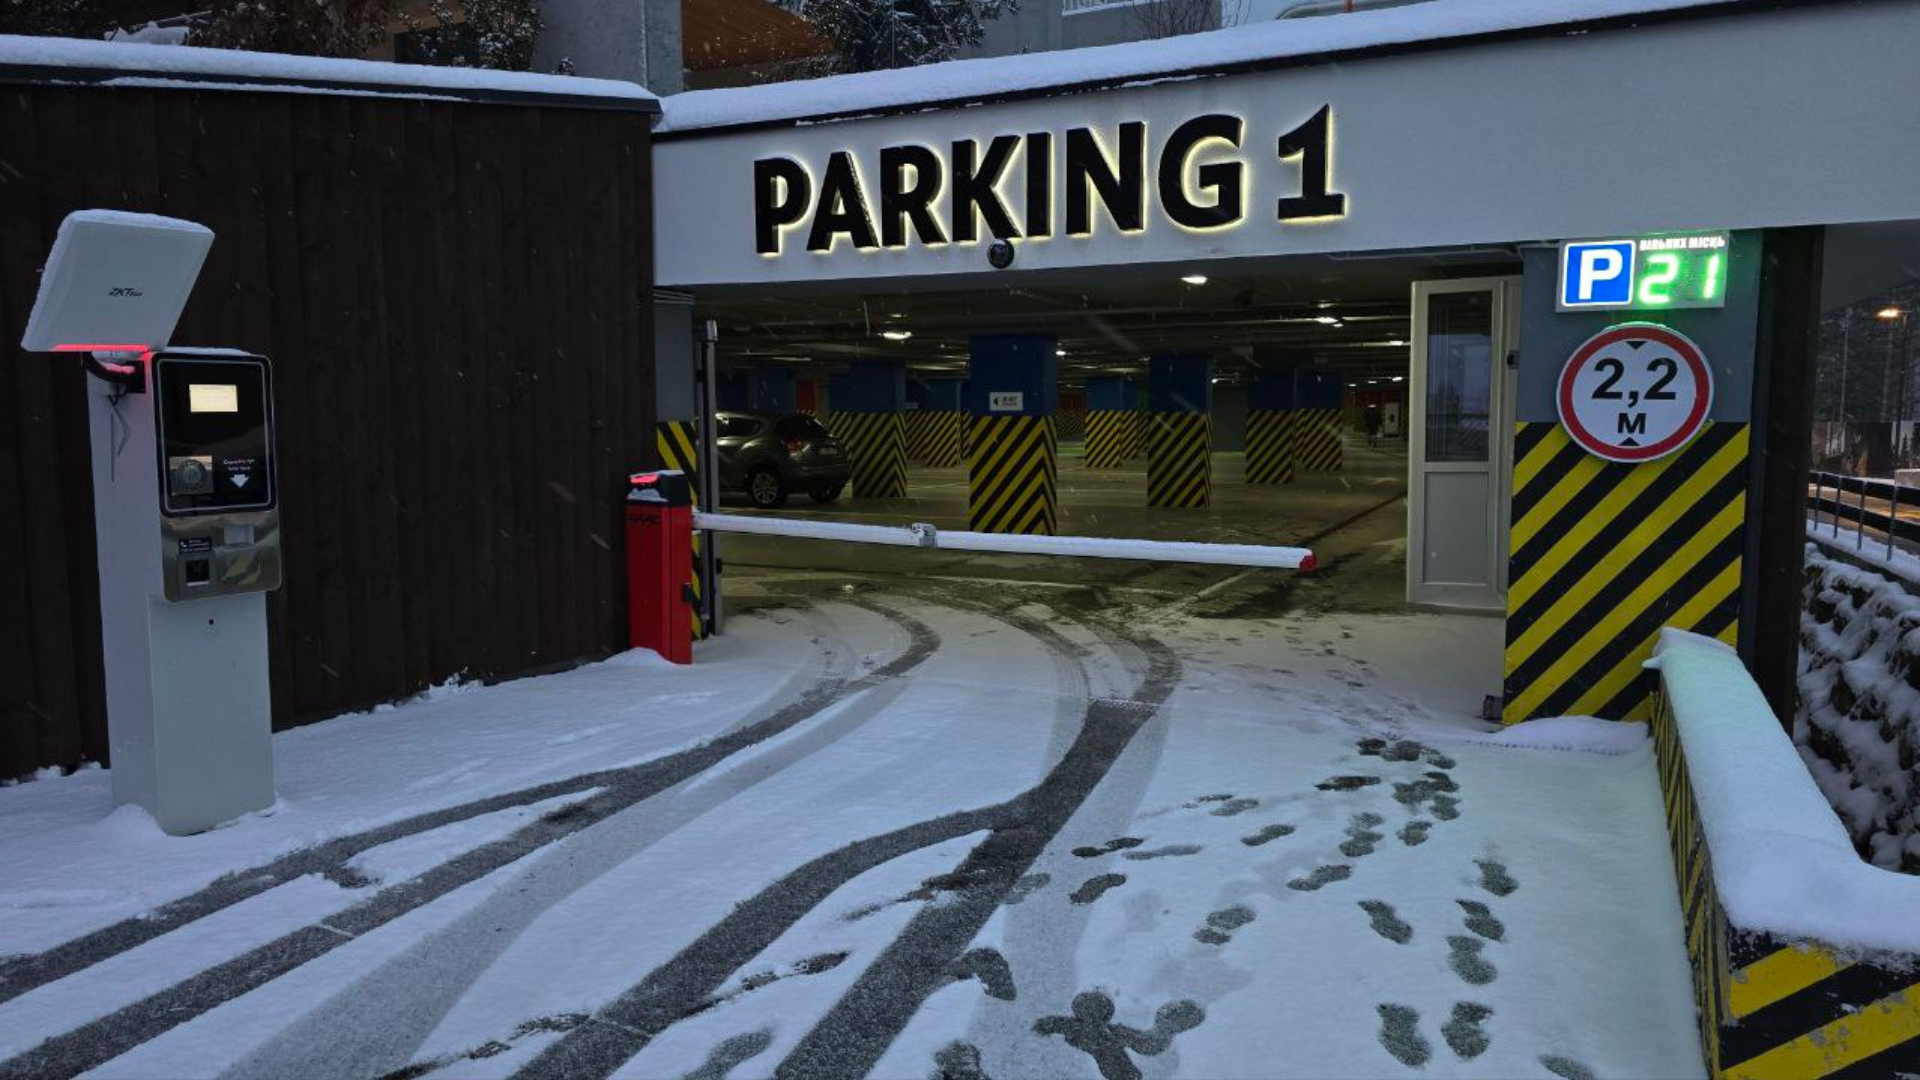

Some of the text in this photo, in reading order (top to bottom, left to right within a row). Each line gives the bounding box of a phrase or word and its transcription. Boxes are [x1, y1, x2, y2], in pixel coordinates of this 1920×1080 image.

[753, 103, 1346, 255] PARKING 1
[1578, 248, 1623, 300] P
[1638, 253, 1720, 304] 21
[1591, 357, 1679, 408] 2,2
